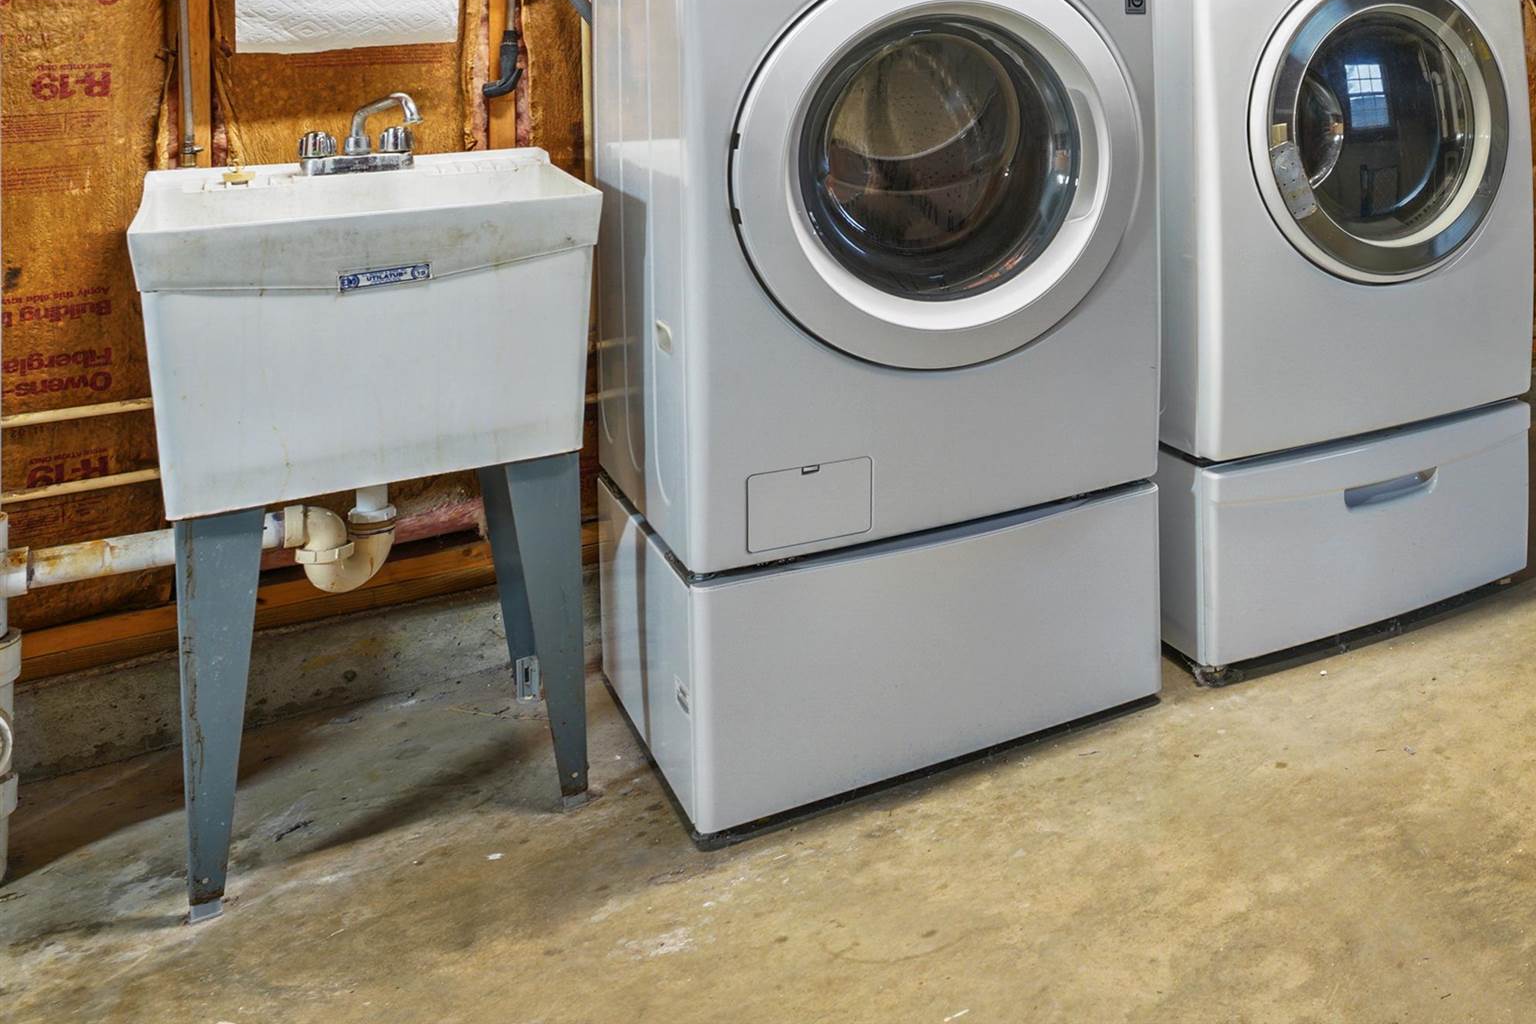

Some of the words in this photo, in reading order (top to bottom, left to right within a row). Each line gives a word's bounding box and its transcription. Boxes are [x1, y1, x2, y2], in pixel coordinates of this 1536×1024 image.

[32, 73, 112, 102] R-19
[19, 298, 113, 324] Building
[0, 347, 113, 378] Fibergla
[0, 371, 113, 401] Owens-
